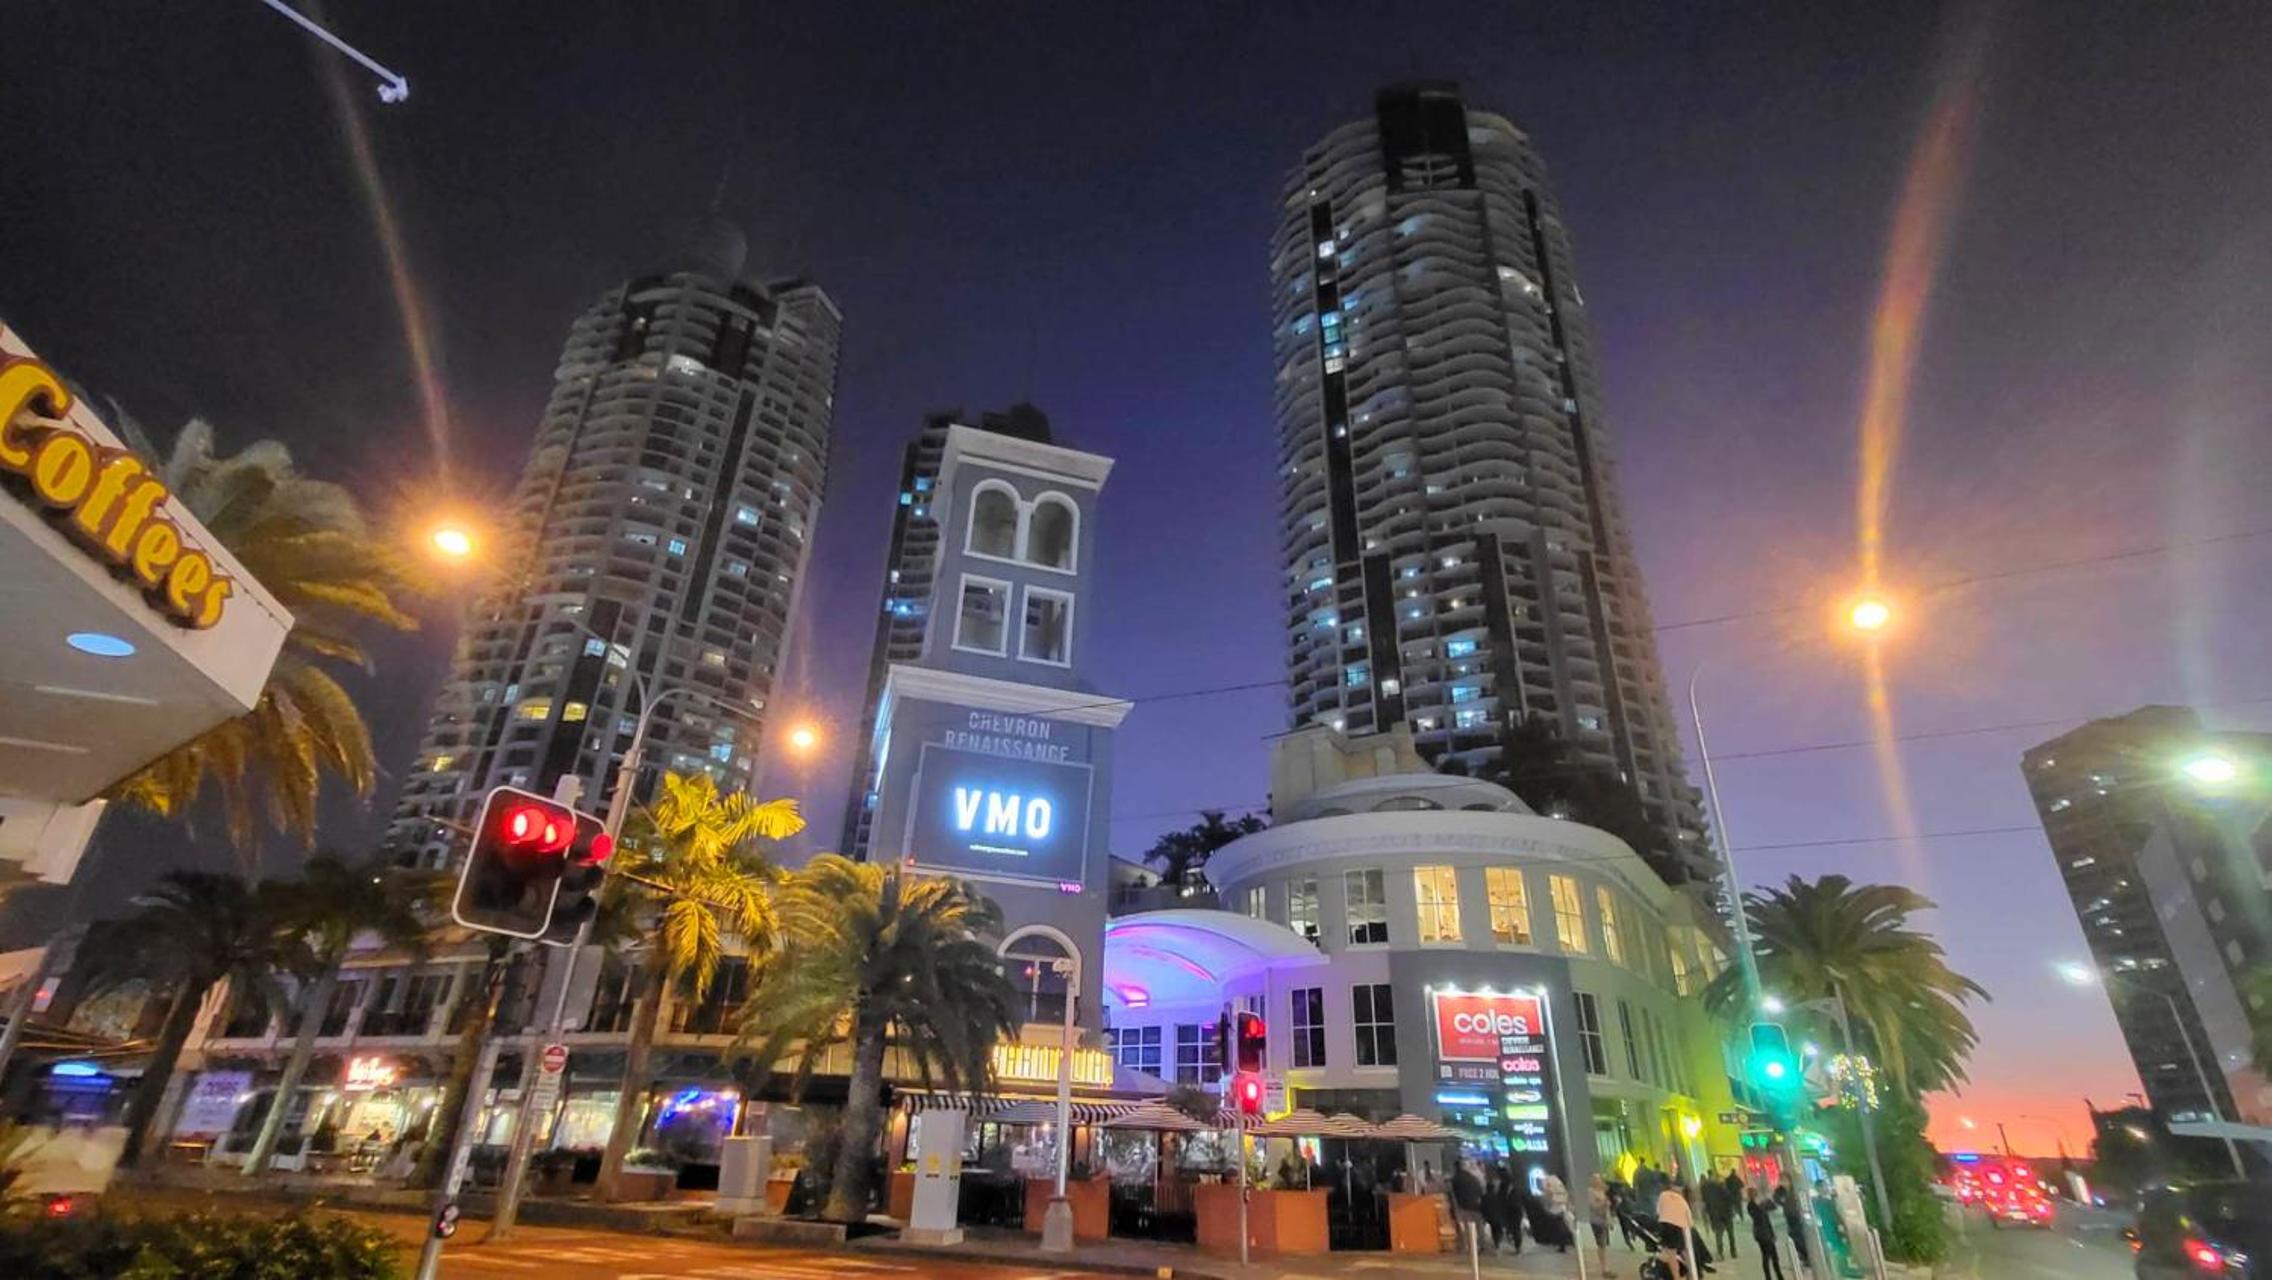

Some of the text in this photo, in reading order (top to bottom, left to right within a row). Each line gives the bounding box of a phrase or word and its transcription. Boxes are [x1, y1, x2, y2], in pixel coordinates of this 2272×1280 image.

[0, 355, 234, 629] Coffees
[968, 711, 1051, 741] CHEVRON
[944, 730, 1070, 763] RENAISSANCE
[954, 786, 1052, 840] VMO
[1454, 1009, 1528, 1034] coles
[1502, 1057, 1540, 1071] coles
